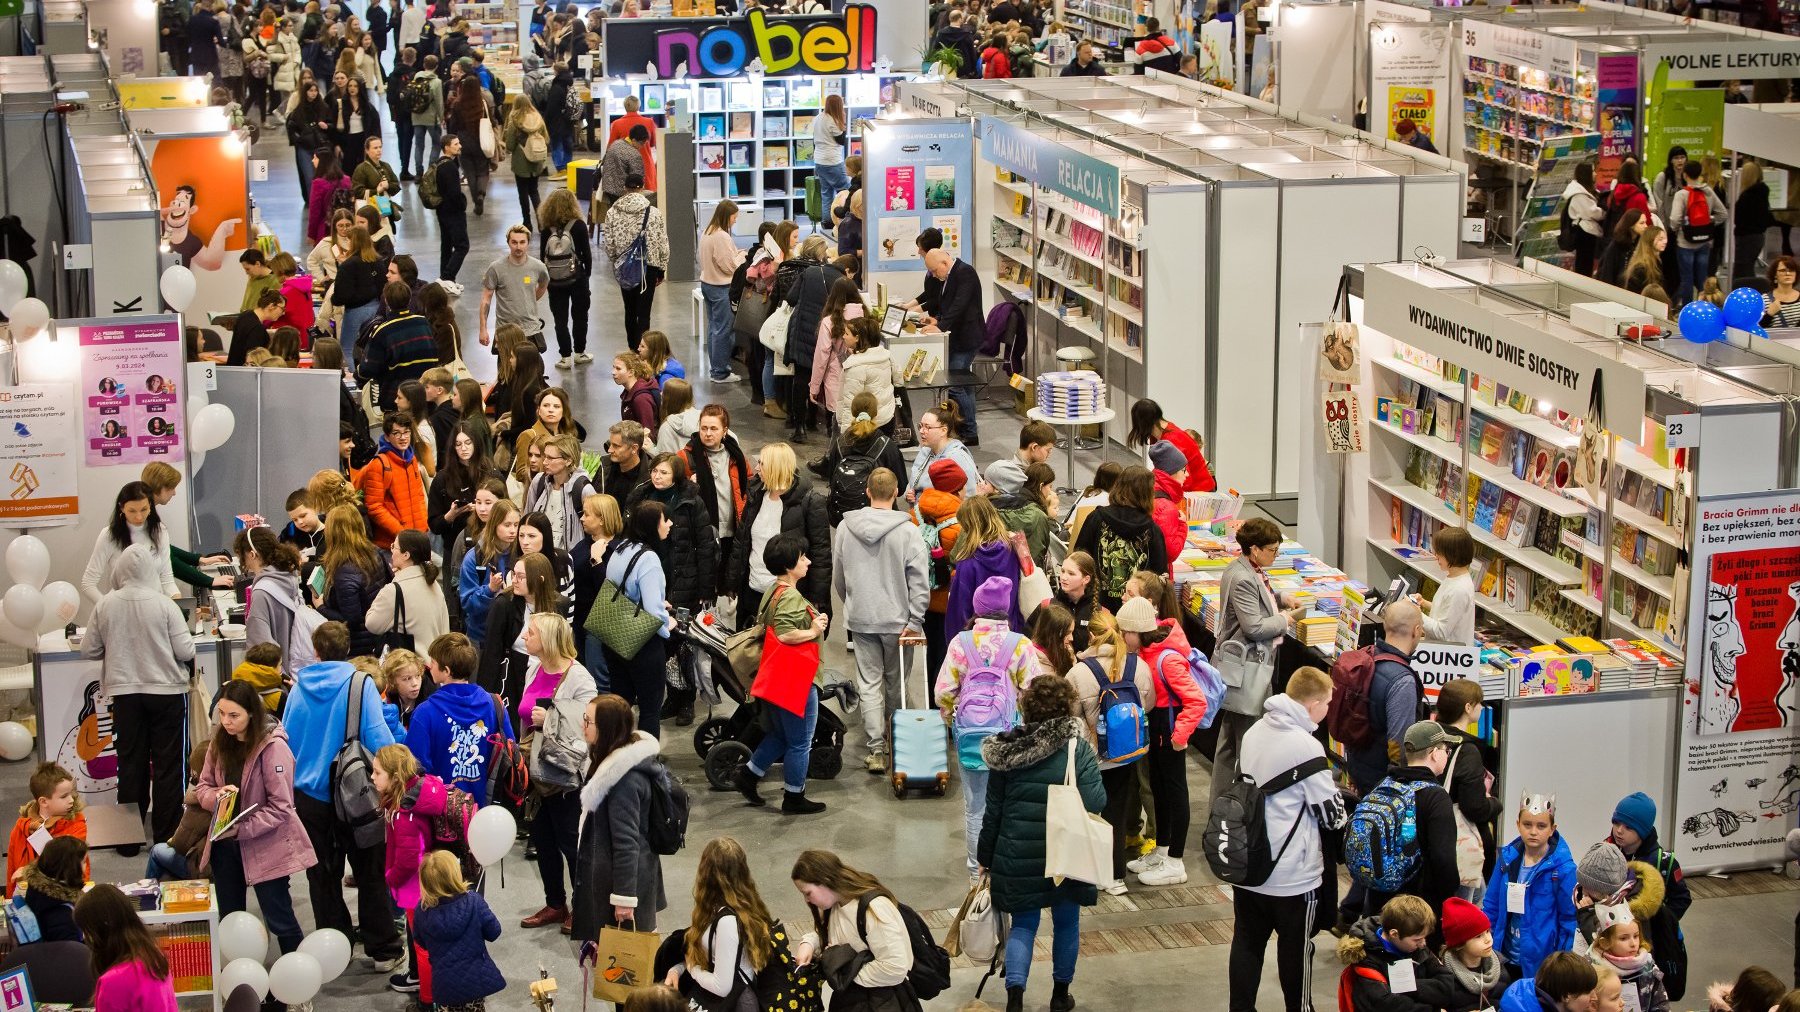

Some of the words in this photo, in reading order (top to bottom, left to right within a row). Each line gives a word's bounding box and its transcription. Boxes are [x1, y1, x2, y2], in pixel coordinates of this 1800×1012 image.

[656, 3, 877, 78] nobell
[1466, 30, 1476, 47] 36
[1660, 54, 1722, 69] WOLNE
[1727, 52, 1800, 68] LEKTURY
[1399, 109, 1427, 119] CIAŁO
[994, 131, 1038, 174] MAMANIA
[1603, 144, 1632, 157] BAJKA
[1058, 159, 1104, 203] RELACJA
[1472, 224, 1482, 232] 22
[67, 251, 72, 259] 4
[1409, 304, 1493, 354] WYDAWNICTWO
[1496, 339, 1525, 368] DWIE
[1528, 352, 1580, 390] SIOSTRY
[205, 368, 213, 378] 3
[13, 392, 44, 400] czytam.pl
[1669, 423, 1683, 435] 23
[1353, 430, 1362, 452] dwie
[1704, 509, 1734, 520] Bracia
[1737, 507, 1769, 517] Grimm
[1772, 505, 1787, 514] nie
[1703, 523, 1720, 531] Bez
[1723, 518, 1774, 532] upiększeń,
[1777, 517, 1794, 526] bez
[1702, 535, 1705, 543] i
[1708, 535, 1725, 543] bez
[1728, 530, 1776, 544] prawienia
[1717, 557, 1734, 571] Żyli
[1736, 558, 1760, 569] długo
[1734, 570, 1752, 583] póki
[1755, 571, 1768, 579] nie
[1753, 608, 1774, 618] braci
[1750, 621, 1776, 630] Grimm
[451, 725, 480, 745] Take
[457, 744, 469, 760] it
[1689, 744, 1708, 752] Wybór
[1744, 738, 1775, 746] pierwszego
[1697, 758, 1711, 766] język
[1713, 756, 1729, 764] polski
[452, 761, 480, 778] chill
